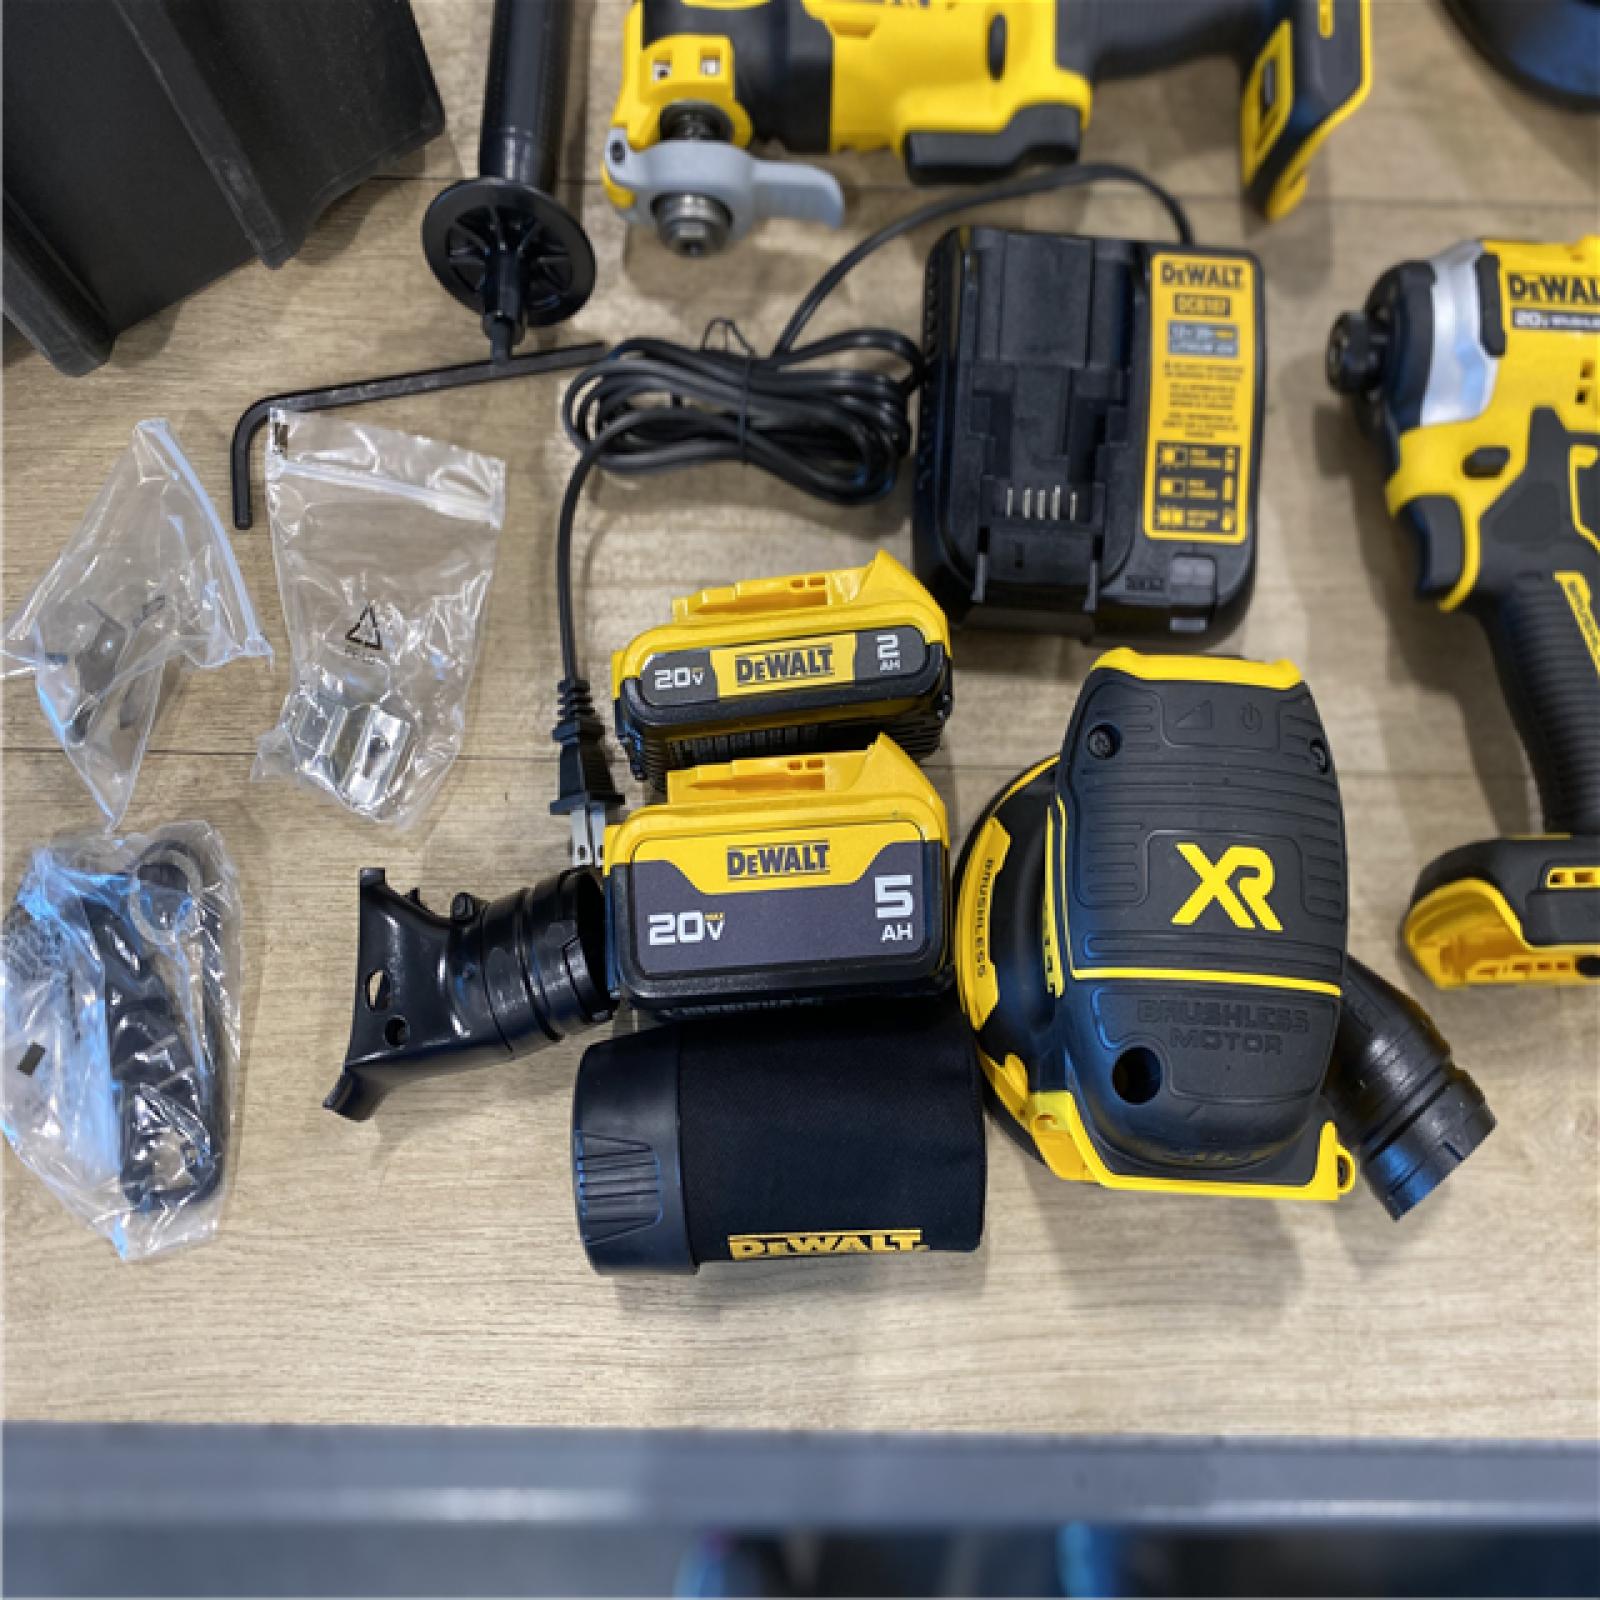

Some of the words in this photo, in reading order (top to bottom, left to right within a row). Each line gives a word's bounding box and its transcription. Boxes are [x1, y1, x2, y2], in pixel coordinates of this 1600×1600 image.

[1160, 260, 1243, 290] DEWALT
[877, 634, 900, 659] 2
[735, 647, 834, 684] DEWALT
[727, 843, 830, 878] DEWALT
[875, 875, 914, 919] 5
[1171, 842, 1284, 931] XR
[881, 922, 914, 943] AH
[976, 859, 993, 978] BRUSHLESS
[1138, 999, 1311, 1034] BRUSHLESS
[1168, 1027, 1284, 1055] MOTOR
